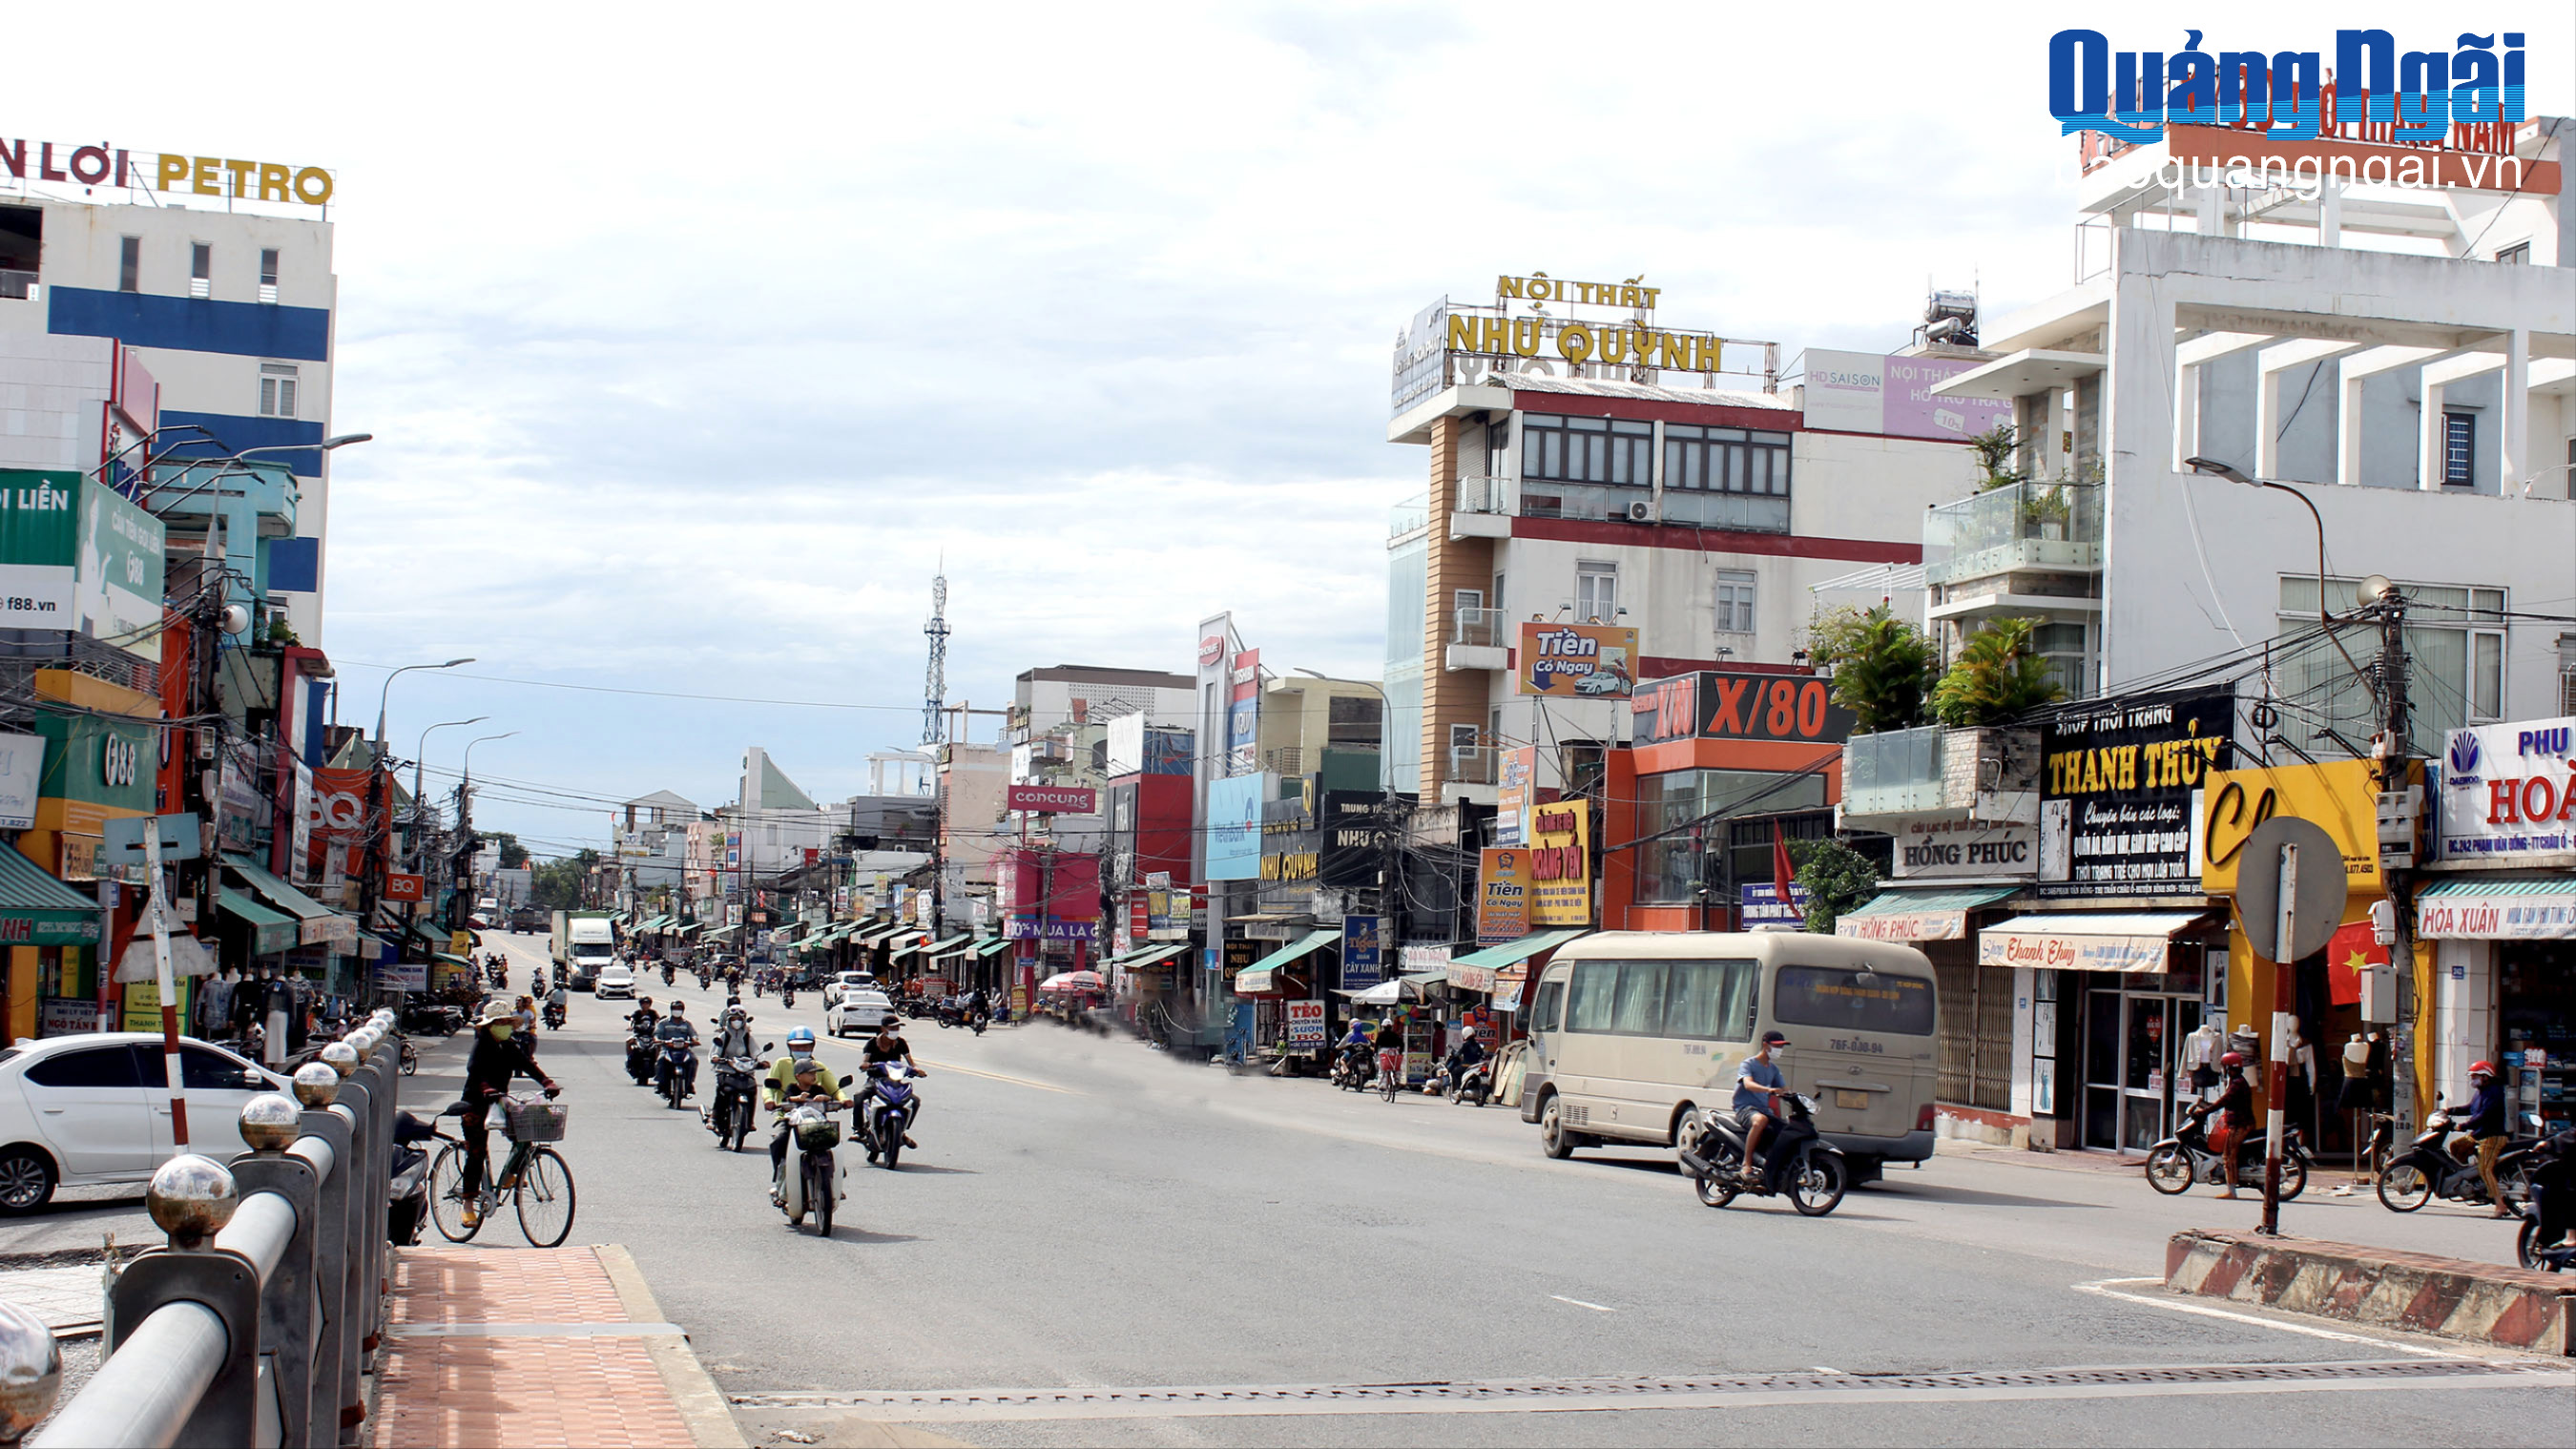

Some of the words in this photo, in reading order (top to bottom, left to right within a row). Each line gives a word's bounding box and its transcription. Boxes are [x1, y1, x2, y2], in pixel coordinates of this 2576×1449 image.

[41, 141, 129, 196] LỢI
[157, 153, 334, 205] PETRO
[1500, 271, 1564, 309] NỘI
[1576, 274, 1661, 309] THẤT
[1447, 314, 1546, 358] NHƯ
[1556, 321, 1722, 373] QUỲNH
[1809, 370, 1828, 383] HD
[1830, 372, 1880, 386] SAISON
[1890, 365, 1918, 383] NỘI
[17, 479, 69, 511] LIỀN
[8, 597, 56, 611] f88.vn
[1537, 627, 1597, 656] Tiền
[1536, 659, 1554, 673] Có
[1555, 661, 1594, 676] Ngay
[1706, 677, 1828, 738] X/80
[2048, 743, 2138, 796] THANH
[2144, 717, 2224, 790] THỦY
[2518, 727, 2569, 759] PHỤ
[310, 790, 366, 830] BQ
[1340, 802, 1369, 814] TRUNG
[2084, 800, 2118, 828] Chuyên
[2119, 804, 2137, 823] bán
[2138, 804, 2156, 822] các
[1531, 838, 1563, 880] HOÀNG
[1563, 831, 1583, 879] YẾN
[1903, 834, 1962, 867] HỒNG
[1967, 829, 2027, 864] PHÚC
[391, 879, 415, 894] BQ
[1487, 880, 1523, 896] Tiền
[1499, 899, 1523, 908] Ngay
[2421, 900, 2454, 933] HÒA
[2458, 901, 2501, 933] XUÂN
[1838, 923, 1858, 938] GYM
[1860, 916, 1886, 940] HỒNG
[1889, 915, 1920, 939] PHÚC
[1348, 936, 1379, 953] Tiger
[2007, 937, 2045, 962] Thanh
